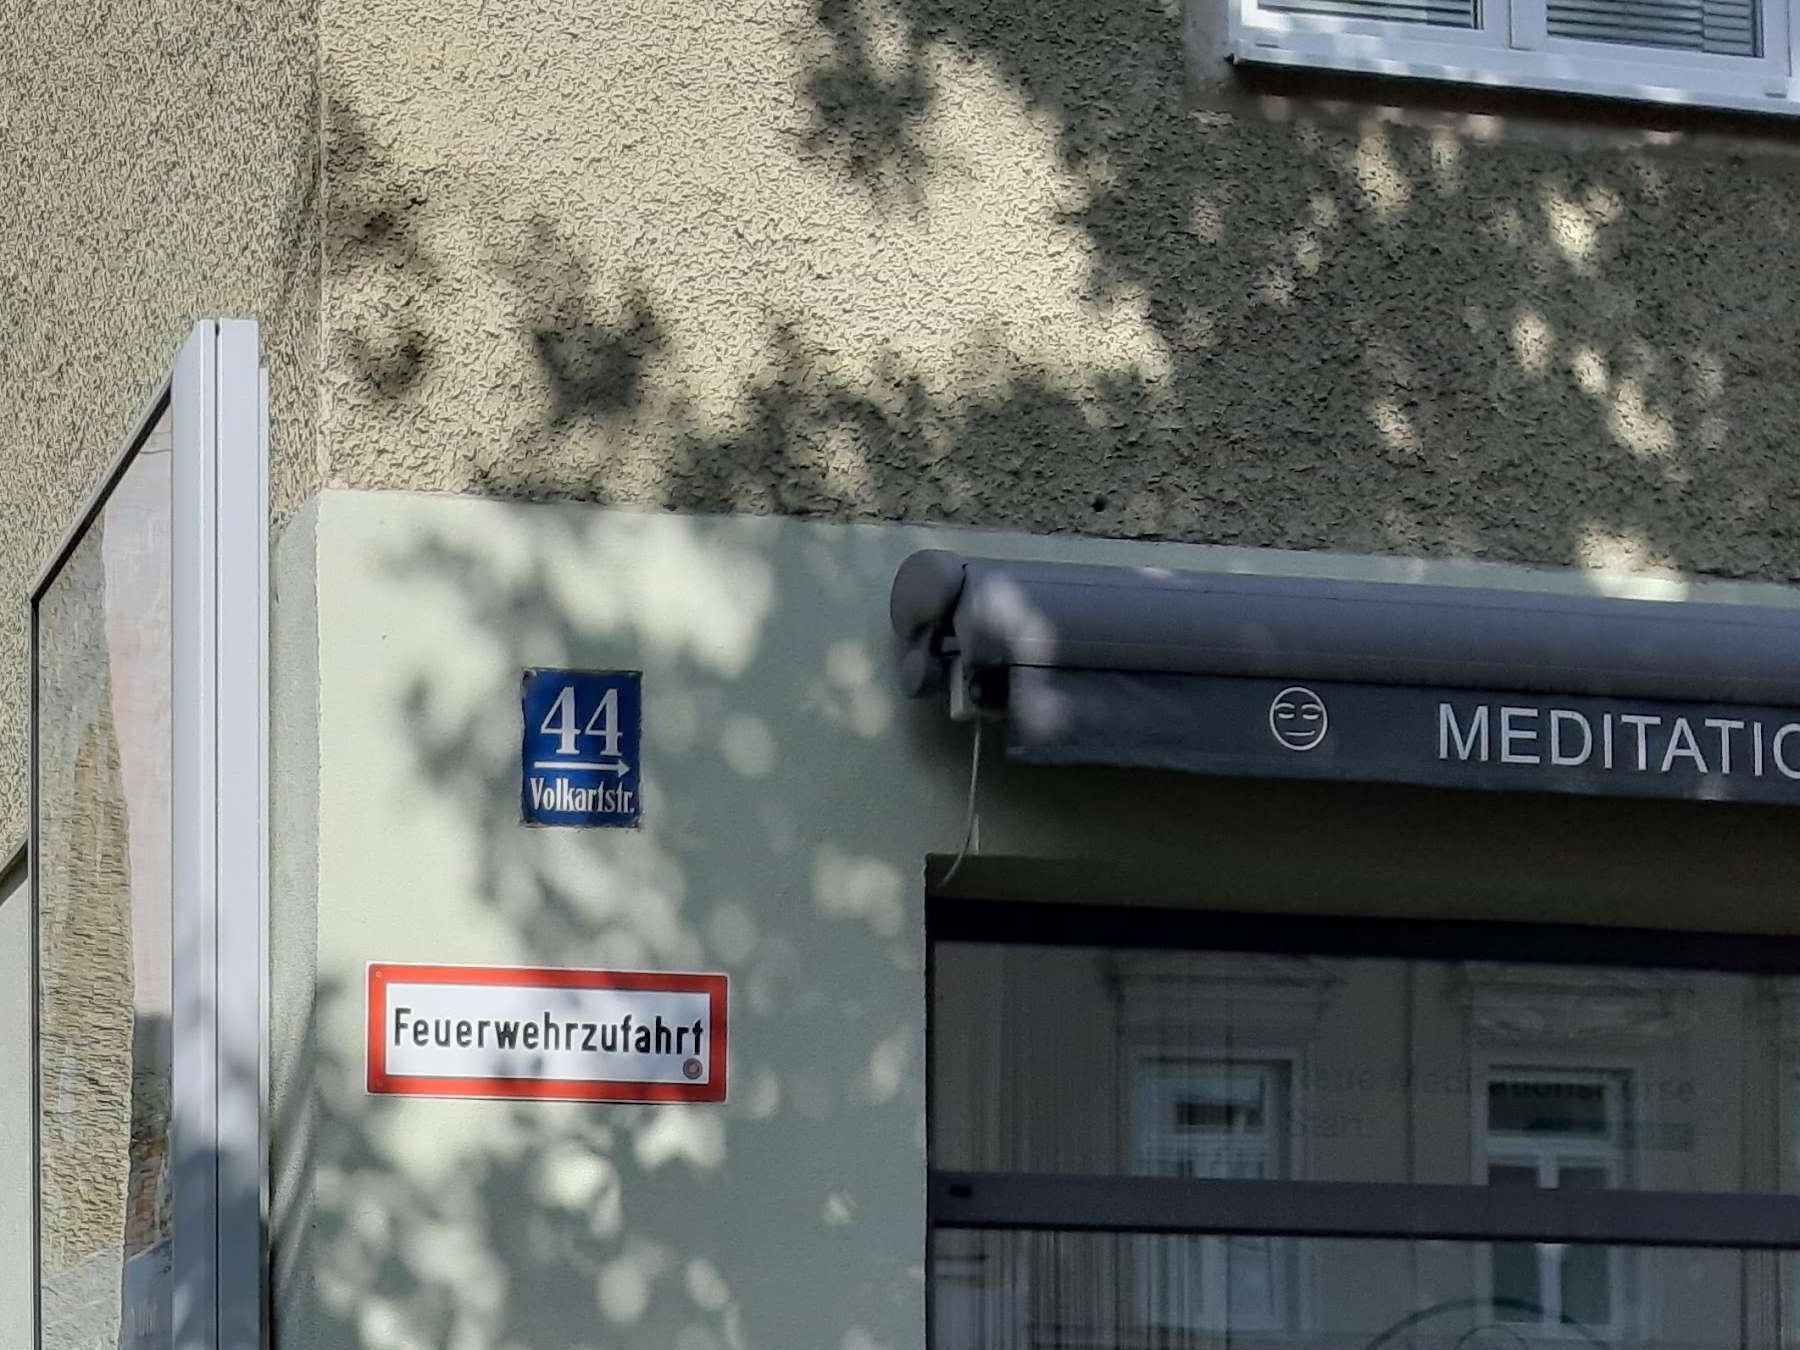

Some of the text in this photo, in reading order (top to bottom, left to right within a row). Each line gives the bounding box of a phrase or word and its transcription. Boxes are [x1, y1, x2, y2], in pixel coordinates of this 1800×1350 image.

[540, 685, 624, 757] 44
[530, 777, 636, 815] Volkartstr.
[393, 1007, 705, 1056] Feuerwehrzufahrt
